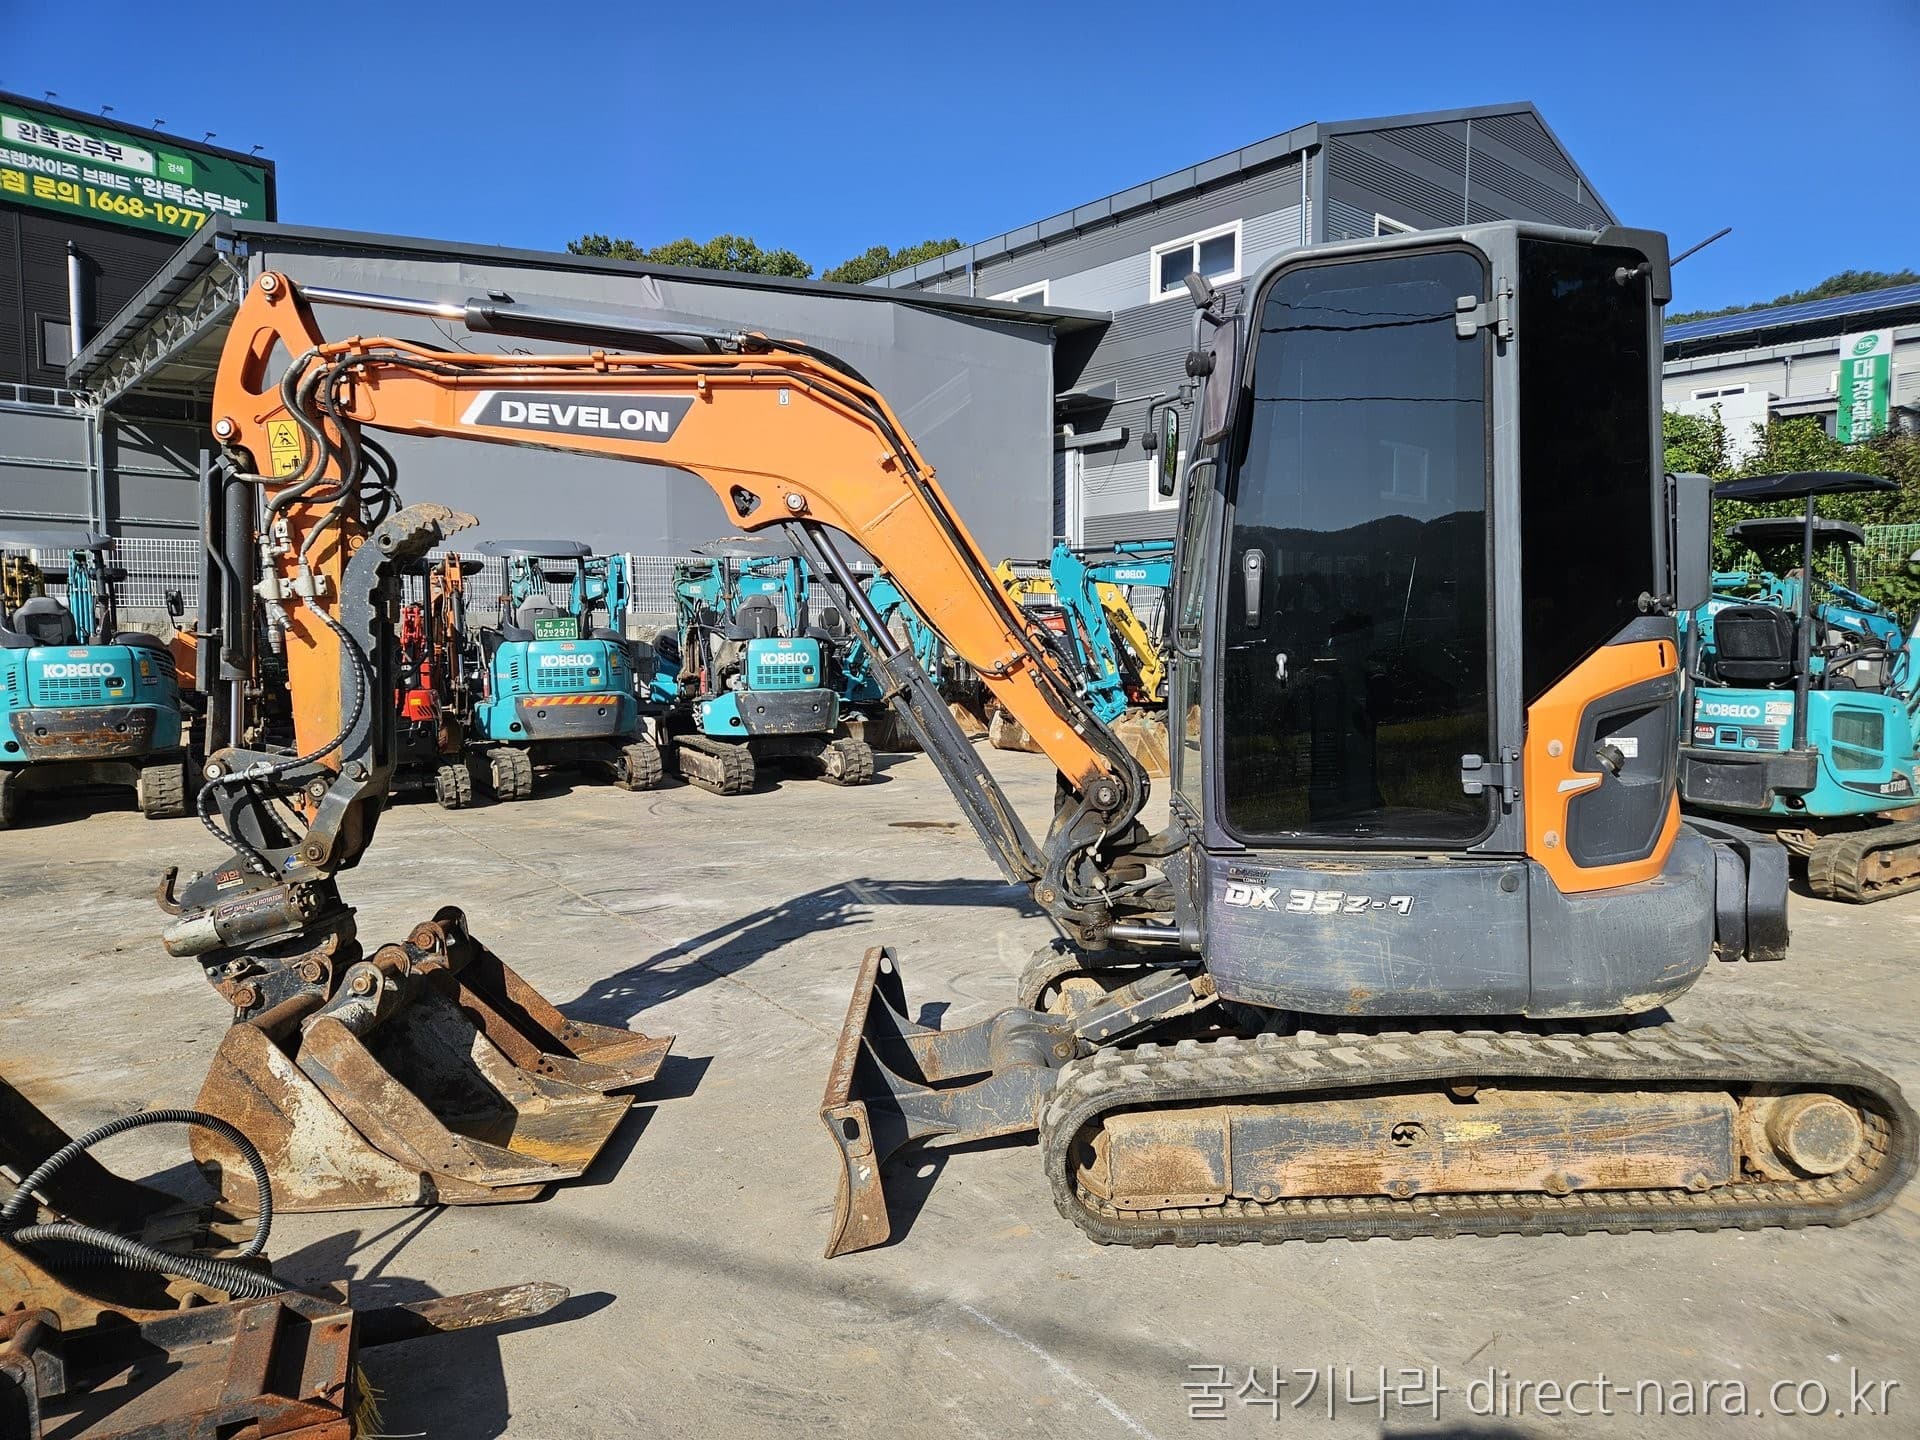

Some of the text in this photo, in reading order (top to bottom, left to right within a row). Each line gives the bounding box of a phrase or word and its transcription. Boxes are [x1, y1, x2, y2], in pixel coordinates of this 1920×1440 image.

[17, 122, 123, 162] 완뚝순두부
[167, 162, 185, 175] 검색
[83, 167, 132, 192] 브랜드
[0, 168, 206, 231] 점 문의 1668-1977
[500, 400, 669, 433] DEVELON
[1115, 569, 1147, 579] KOBELCO
[540, 654, 595, 667] KOBELCO
[760, 652, 810, 665] KOBELCO
[42, 662, 115, 678] KOBELCO
[1705, 703, 1760, 718] KOBELCO
[1224, 883, 1281, 912] DX
